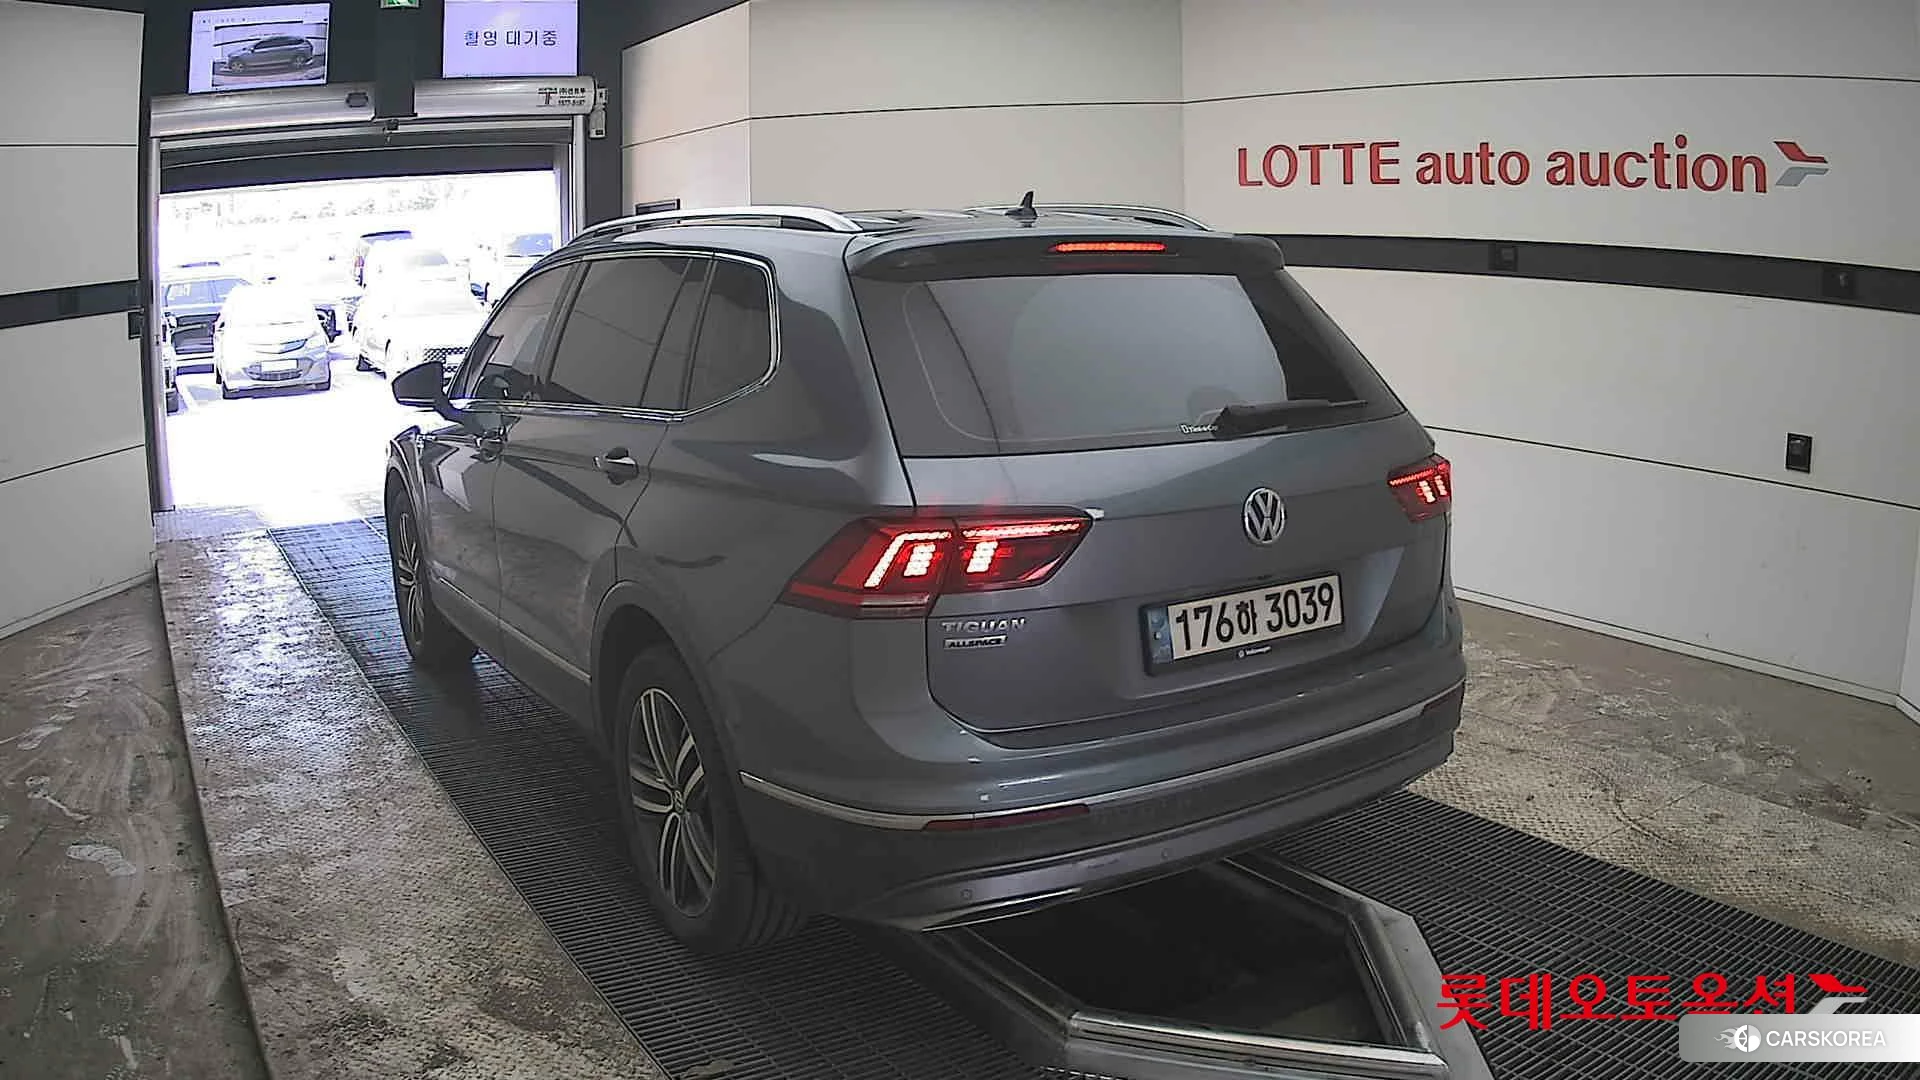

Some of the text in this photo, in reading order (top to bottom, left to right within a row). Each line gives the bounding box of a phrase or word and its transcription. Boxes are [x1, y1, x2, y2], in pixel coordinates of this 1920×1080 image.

[506, 30, 558, 46] 대기중
[1237, 134, 1768, 194] LOTTE auto auction
[942, 617, 1026, 633] TIGUAN
[1176, 582, 1334, 651] 176하 3039
